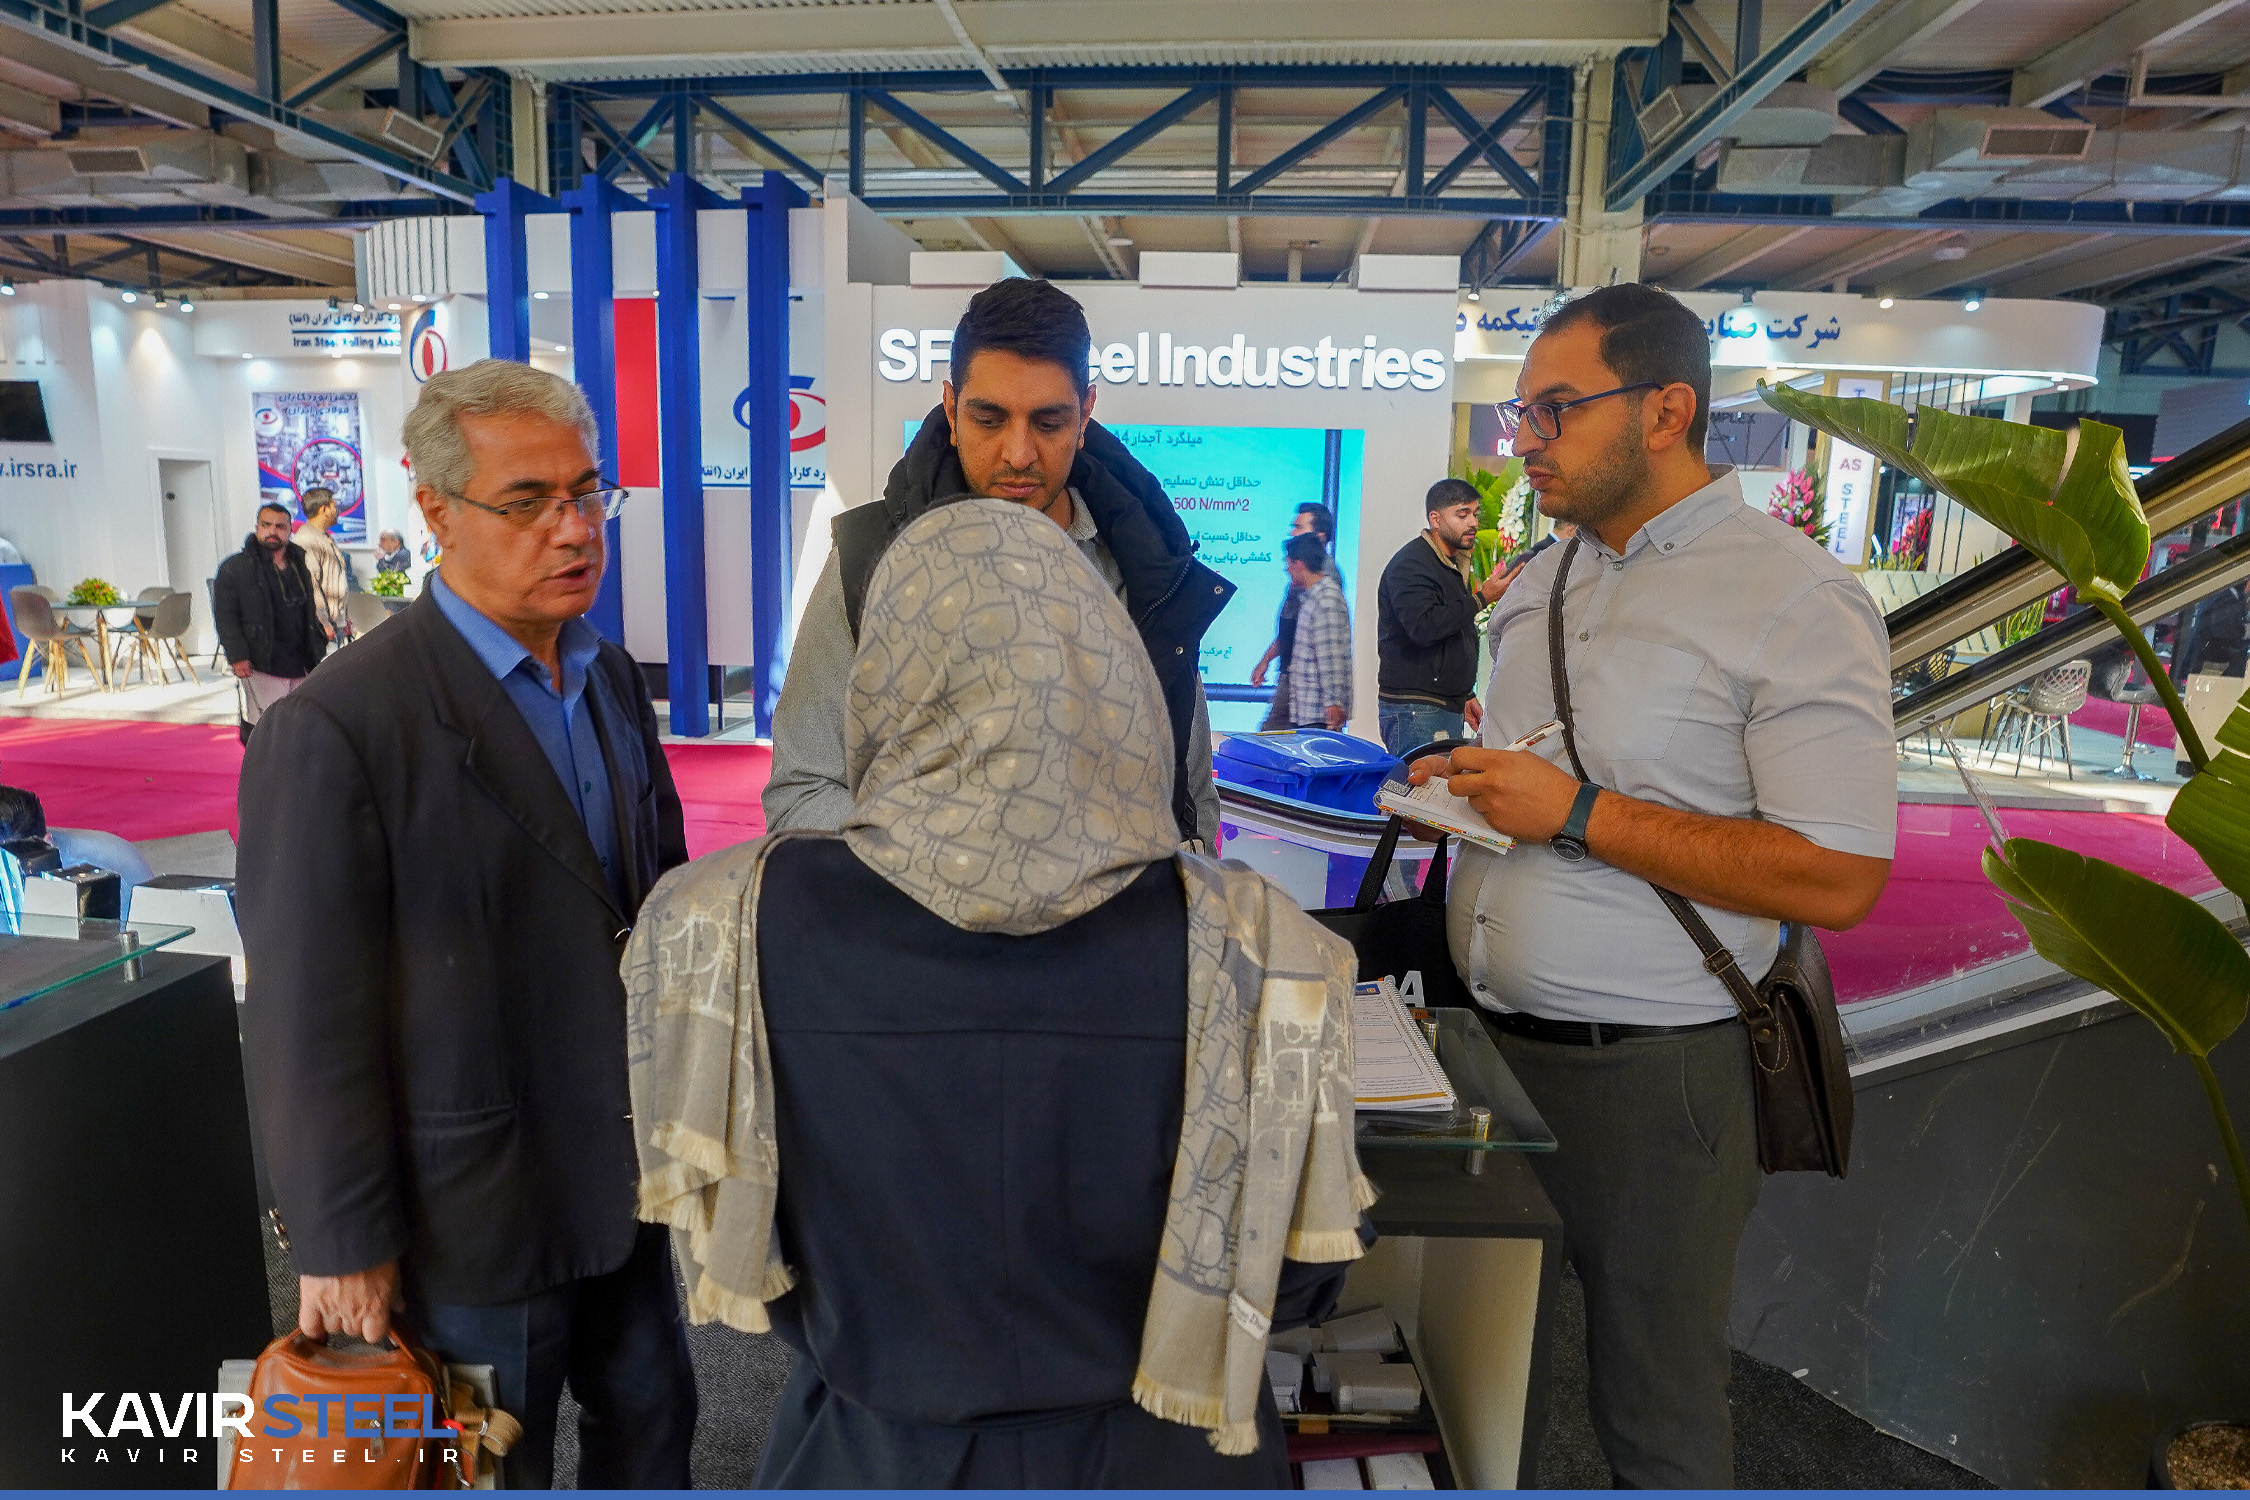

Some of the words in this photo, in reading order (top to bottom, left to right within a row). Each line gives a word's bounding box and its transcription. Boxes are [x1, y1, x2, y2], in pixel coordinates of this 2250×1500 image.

[1705, 309, 1758, 344] صنای
[1765, 310, 1841, 349] شرکت
[1158, 332, 1448, 391] Industries
[1166, 430, 1204, 447] میلگرد
[0, 457, 78, 478] .irsra.ir
[1839, 457, 1863, 472] AS
[1162, 475, 1197, 489] تسلیم
[1199, 475, 1225, 490] تنش
[1227, 476, 1262, 490] حداقل
[1173, 497, 1196, 510] 500
[1199, 497, 1250, 512] N/mm^2
[1835, 482, 1854, 554] STEEL
[1231, 531, 1261, 544] حداقل
